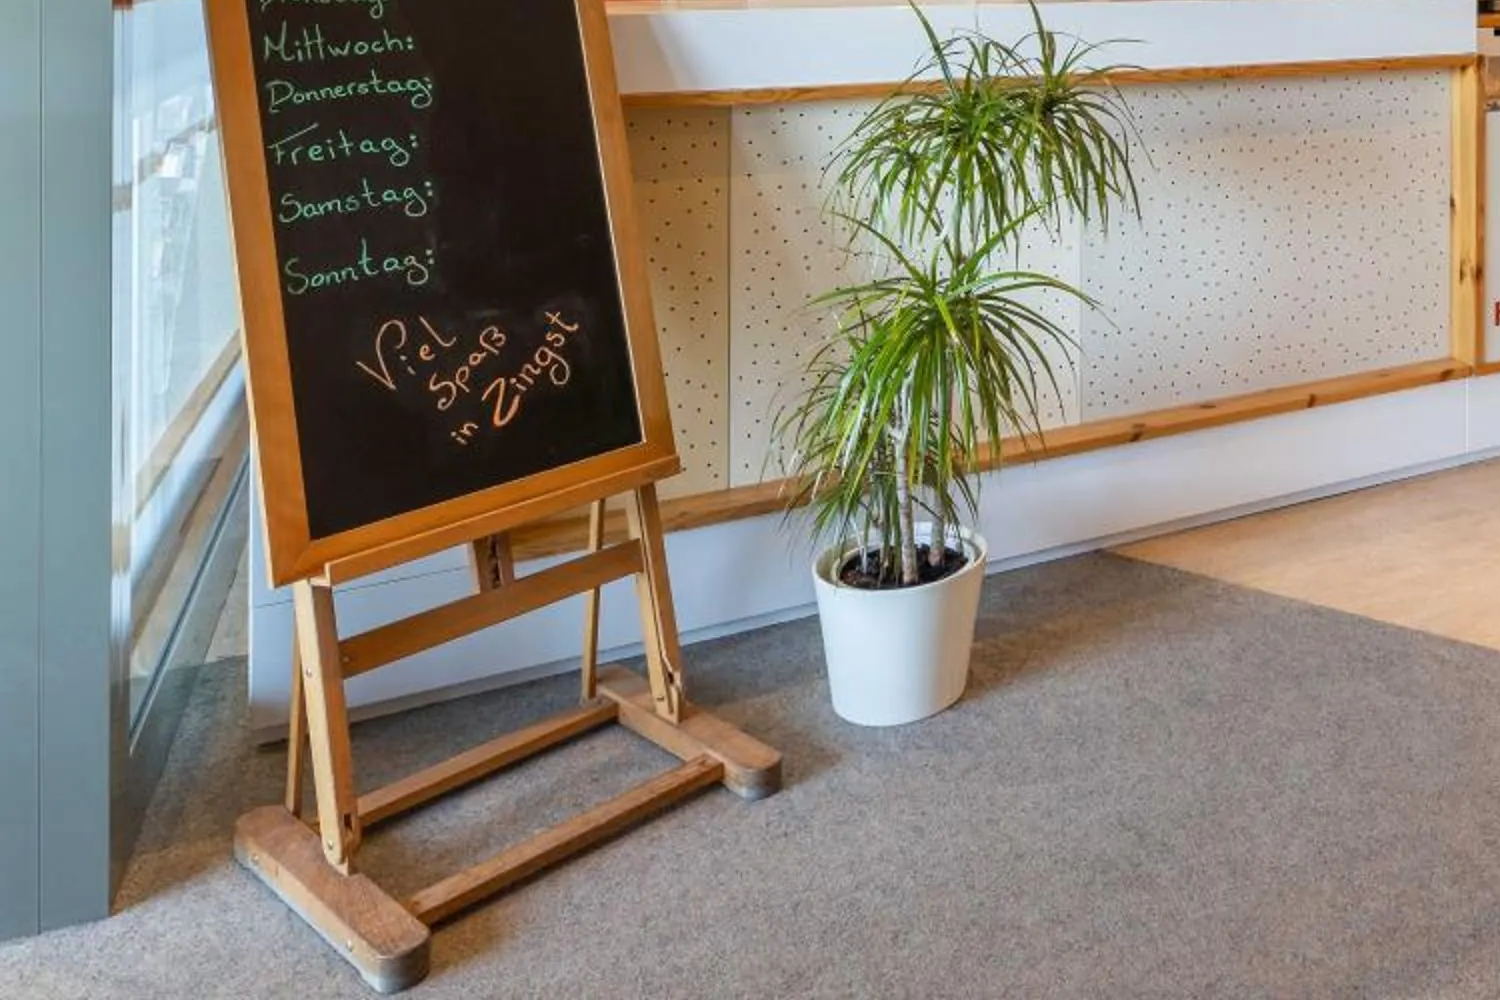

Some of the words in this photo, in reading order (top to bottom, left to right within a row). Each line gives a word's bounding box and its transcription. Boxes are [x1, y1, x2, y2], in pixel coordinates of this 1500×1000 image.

[263, 20, 414, 63] Mittwoch:
[267, 69, 433, 113] Donnerstag:
[269, 123, 418, 167] Freitag:
[279, 178, 434, 223] Samstag:
[286, 238, 435, 294] Sonntag:
[356, 315, 457, 391] Viel
[450, 420, 479, 446] in
[482, 311, 579, 427] Zingst
